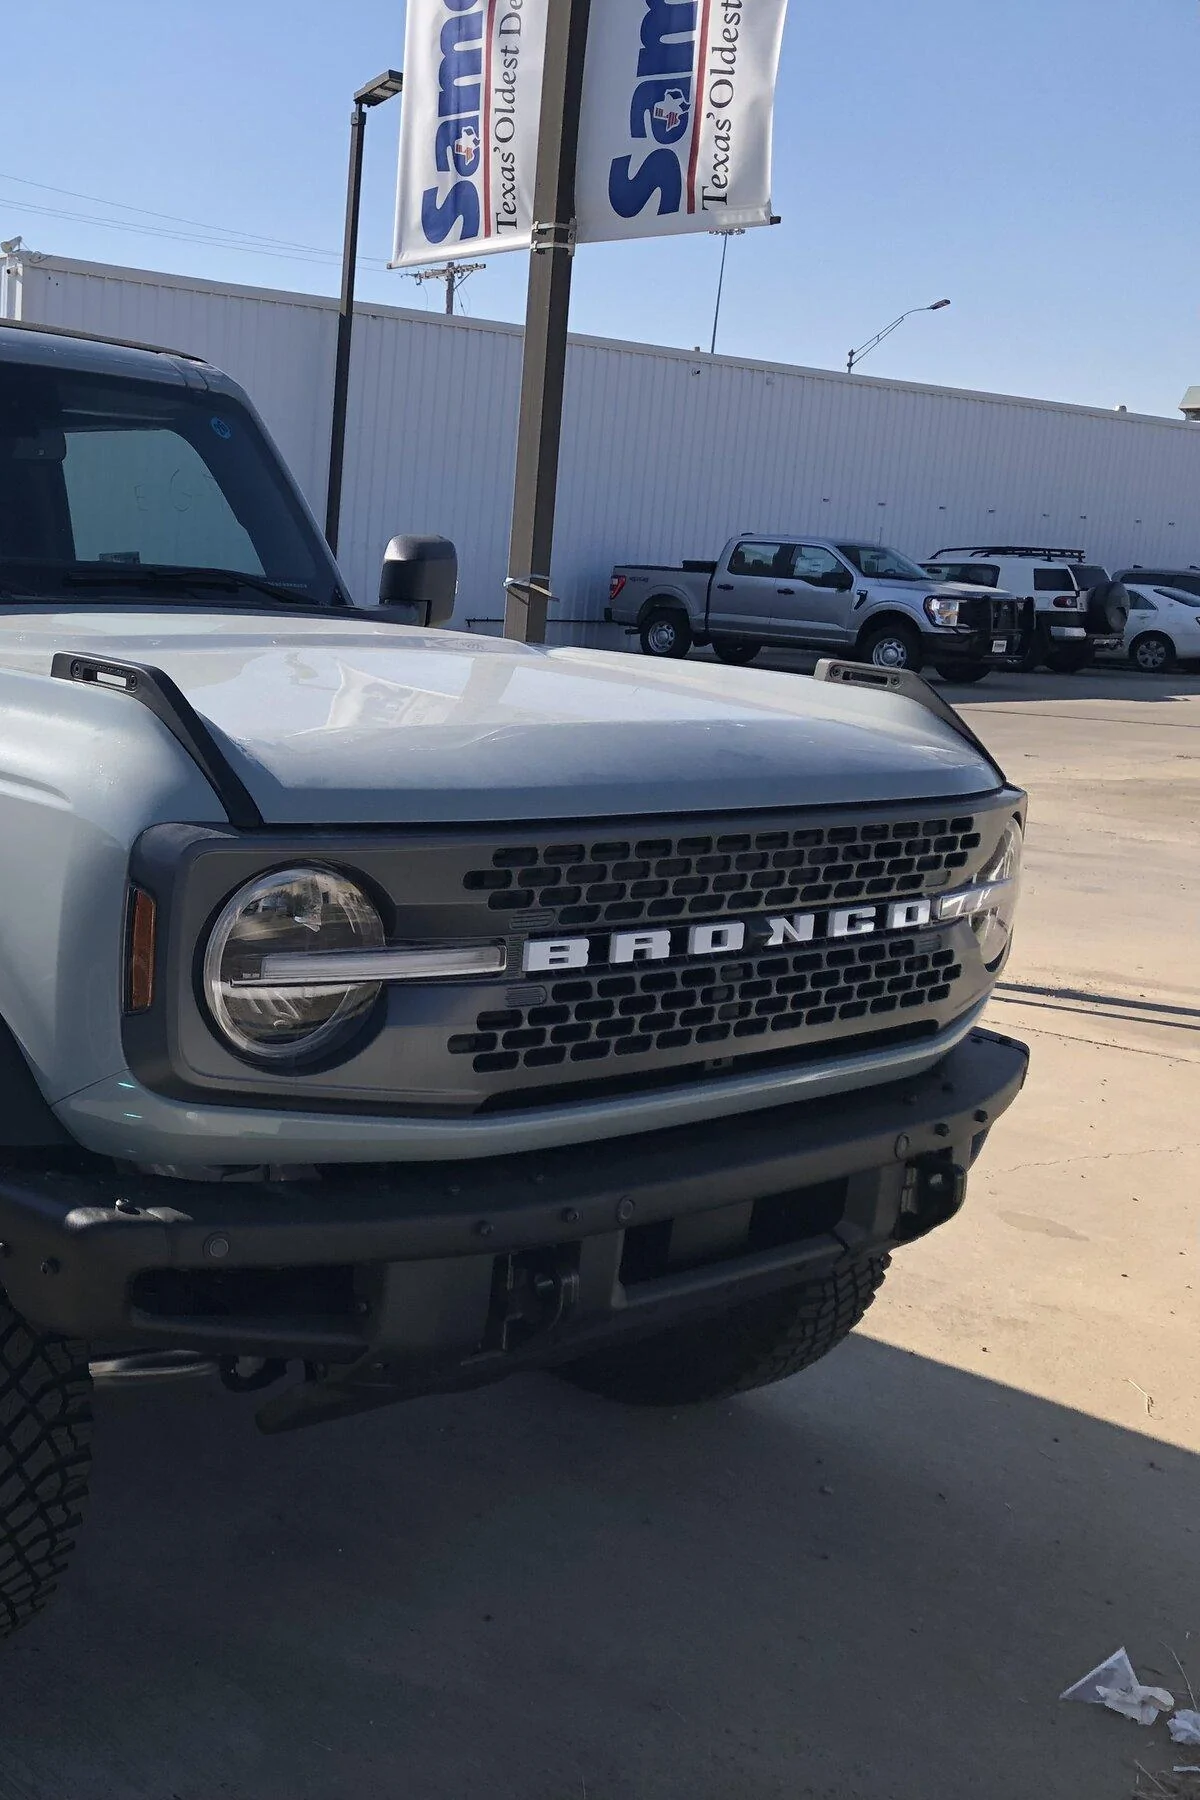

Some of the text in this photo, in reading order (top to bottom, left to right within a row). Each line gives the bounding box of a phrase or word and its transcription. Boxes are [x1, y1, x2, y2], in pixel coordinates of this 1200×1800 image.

[494, 45, 520, 143] Oldest
[709, 0, 744, 109] Oldest
[421, 0, 484, 244] Sam
[522, 899, 931, 973] BRONCO
